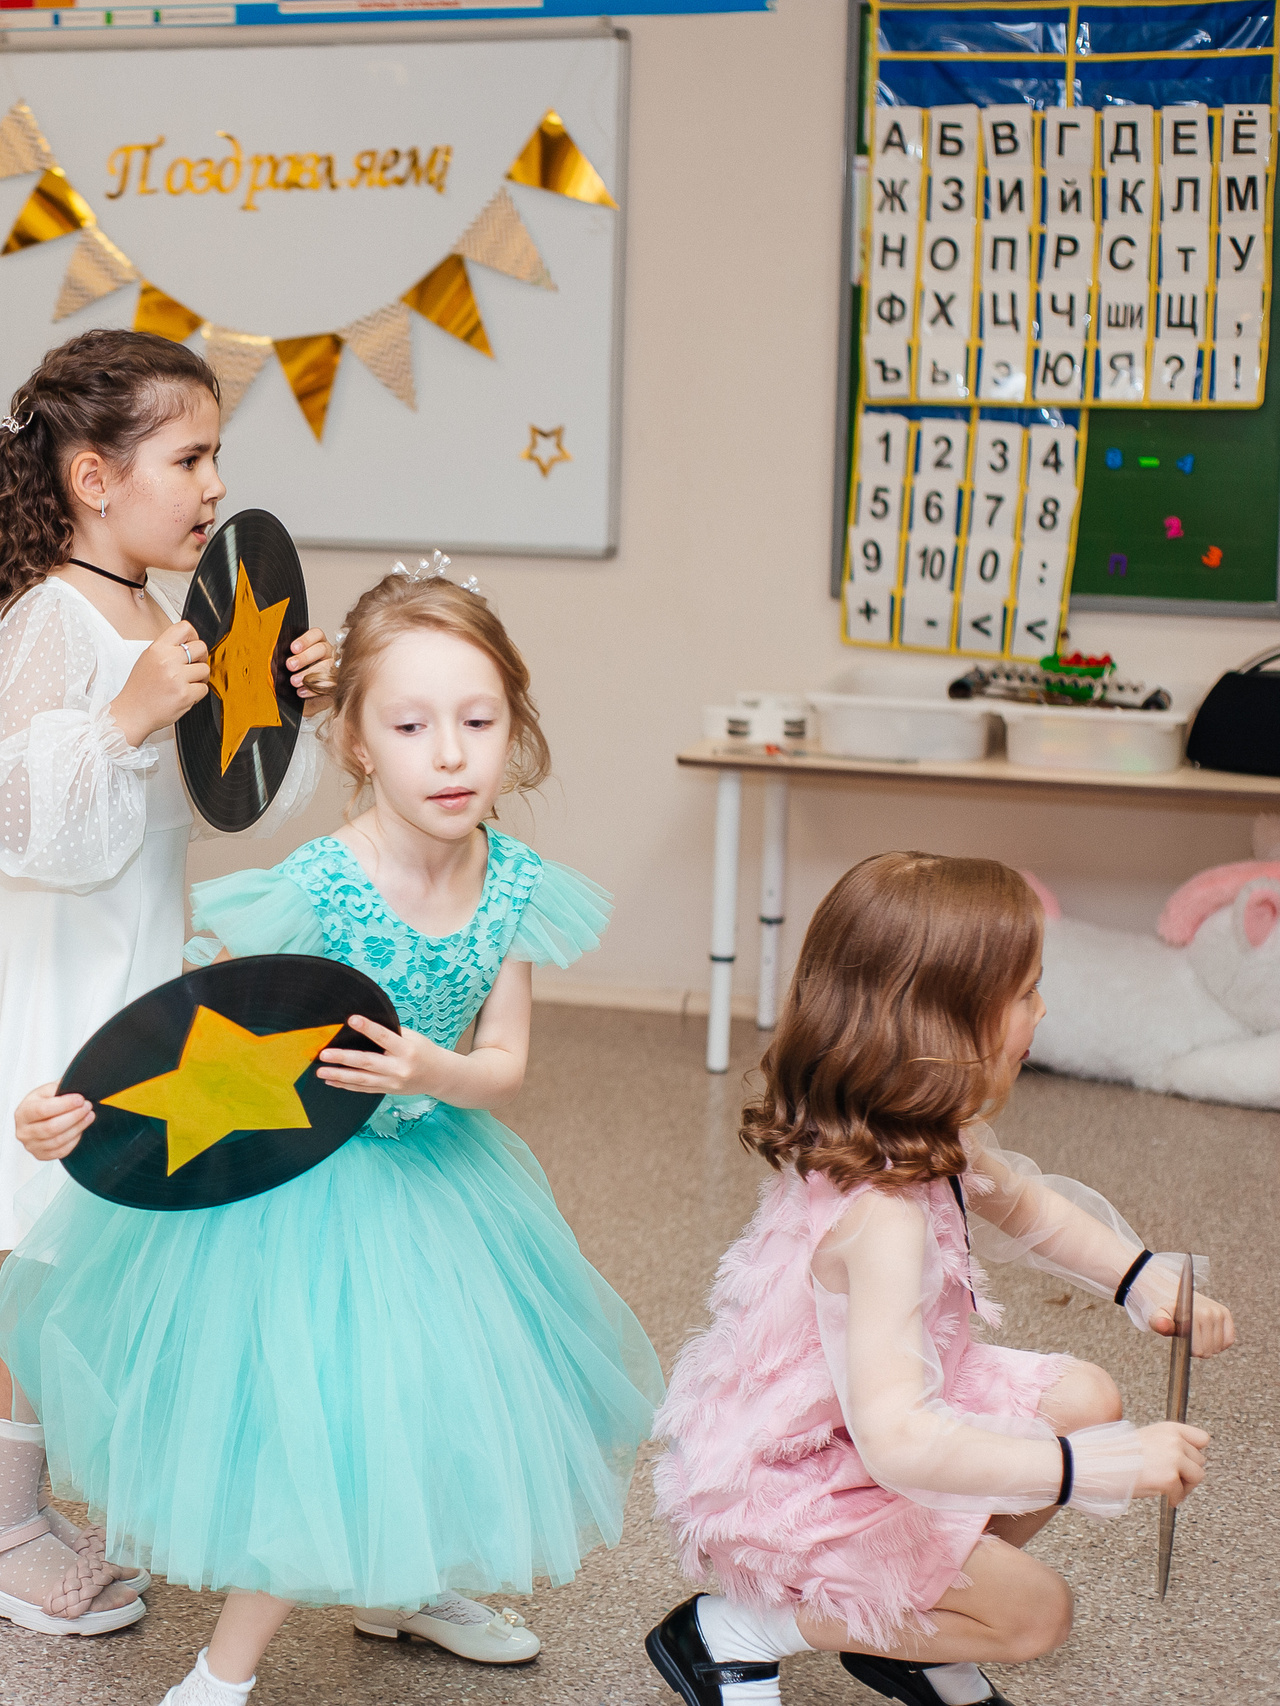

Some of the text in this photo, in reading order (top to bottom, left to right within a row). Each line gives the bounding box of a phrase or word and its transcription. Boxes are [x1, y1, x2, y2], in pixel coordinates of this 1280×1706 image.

[882, 108, 1258, 164] А Б В Г Д Е Ё
[877, 178, 908, 213] Ж
[997, 178, 1024, 213] И
[1120, 179, 1145, 214] К
[1172, 177, 1200, 212] Л
[1226, 175, 1259, 212] М
[881, 234, 907, 268] Н
[930, 236, 959, 271] О
[991, 236, 1017, 271] П
[1054, 234, 1080, 269] Р
[1108, 235, 1136, 271] С
[1228, 234, 1256, 271] У
[877, 293, 906, 326] Ф
[930, 292, 955, 327] Х
[992, 292, 1019, 332] Ц
[1051, 293, 1076, 327] Ч
[1166, 293, 1198, 337] Щ
[1042, 352, 1076, 387] Ю
[1109, 352, 1136, 387] Я
[1165, 355, 1185, 390] ?
[1233, 354, 1241, 390] !
[877, 431, 1063, 474] 1 2 3 4
[870, 486, 1060, 531] 5 6 7 8
[862, 540, 882, 573] 9
[919, 545, 946, 581] 10
[979, 549, 1000, 582] 0
[971, 614, 993, 637] <
[1025, 619, 1048, 641] <
